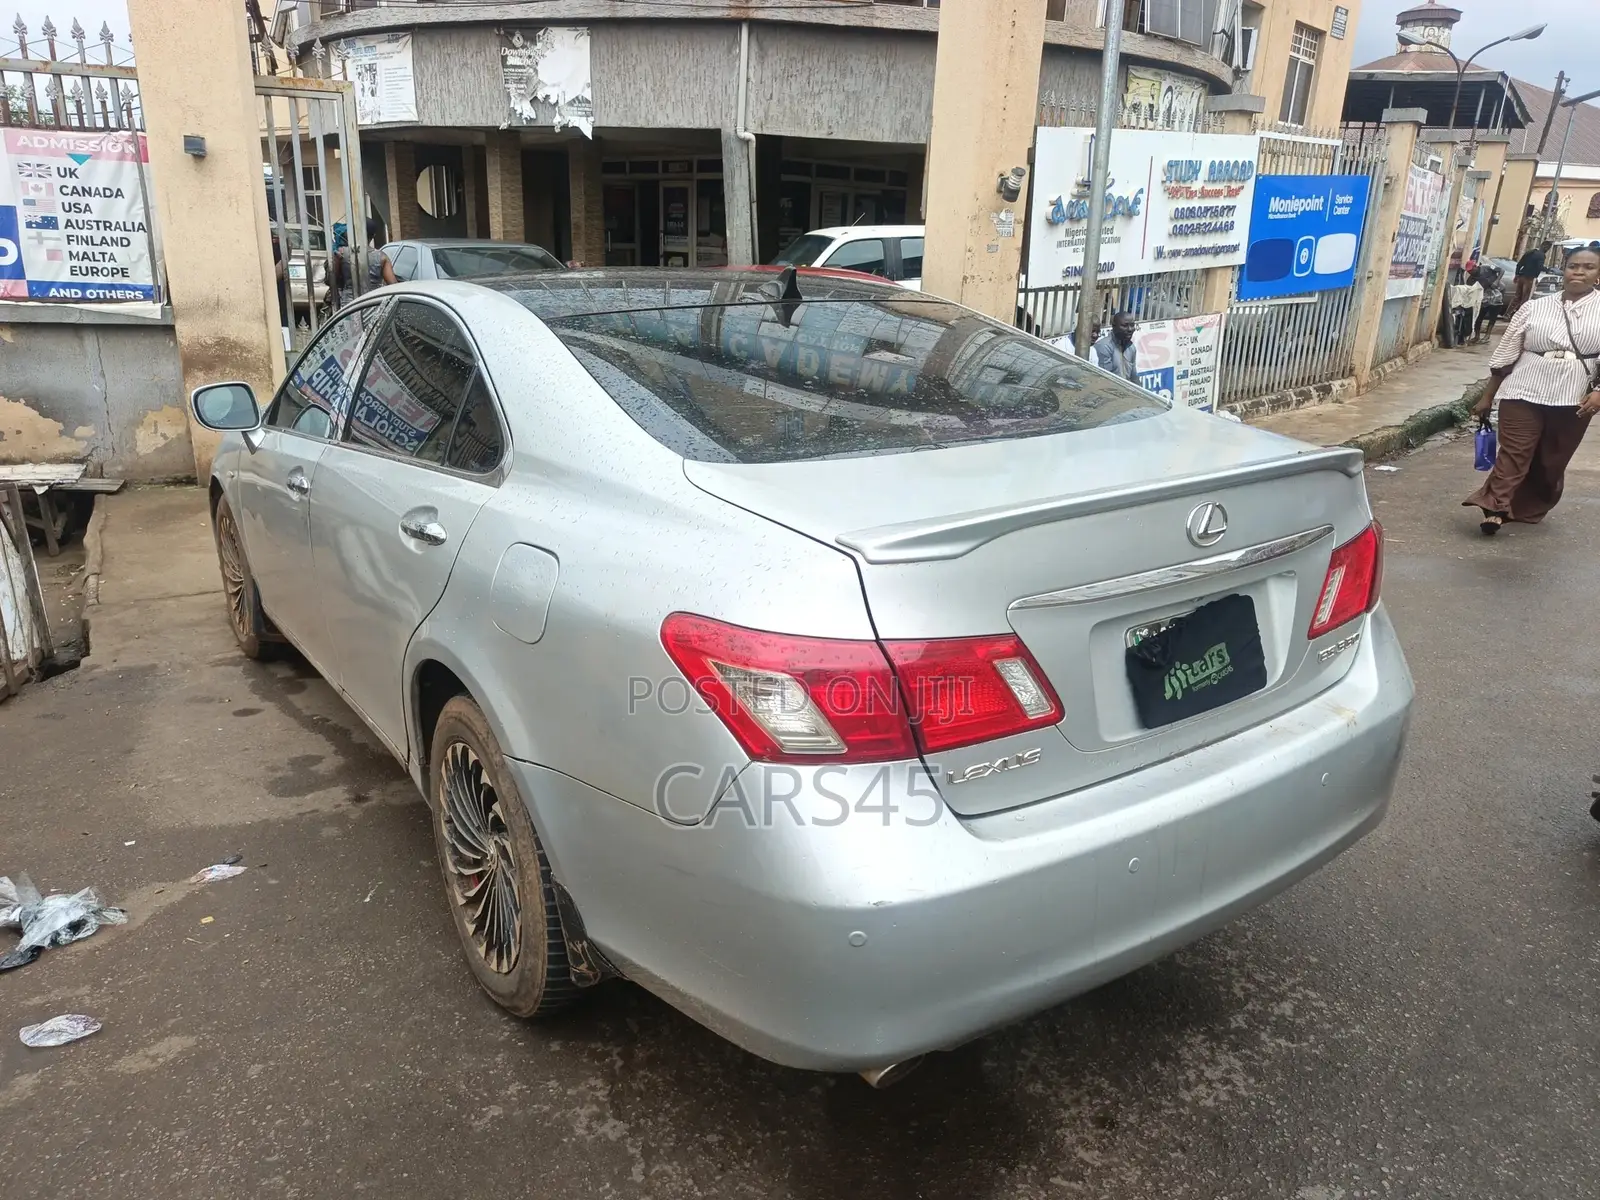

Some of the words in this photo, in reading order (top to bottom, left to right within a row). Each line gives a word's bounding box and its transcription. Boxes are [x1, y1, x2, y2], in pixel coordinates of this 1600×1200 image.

[17, 135, 136, 154] ADMISSION
[56, 167, 80, 180] UK
[1166, 160, 1202, 183] STUDY
[1207, 160, 1255, 181] ABROAD
[59, 185, 125, 199] CANADA
[1269, 194, 1325, 216] Moniepoint
[1335, 194, 1354, 205] Service
[61, 202, 93, 214] USA
[1333, 205, 1351, 216] Center
[64, 218, 148, 234] AUSTRALIA
[66, 234, 132, 248] FINLAND
[68, 250, 118, 263] MALTA
[70, 265, 131, 278] EUROPE
[49, 288, 82, 299] AND
[86, 288, 144, 300] OTHERS
[1190, 336, 1199, 344] UK
[1190, 357, 1202, 366] USA
[1190, 364, 1214, 376] AUSTRALI
[1189, 376, 1212, 387] FINLAND
[1188, 388, 1206, 398] MALTA
[1188, 396, 1208, 407] EUROPE
[946, 747, 1042, 785] LEXUS
